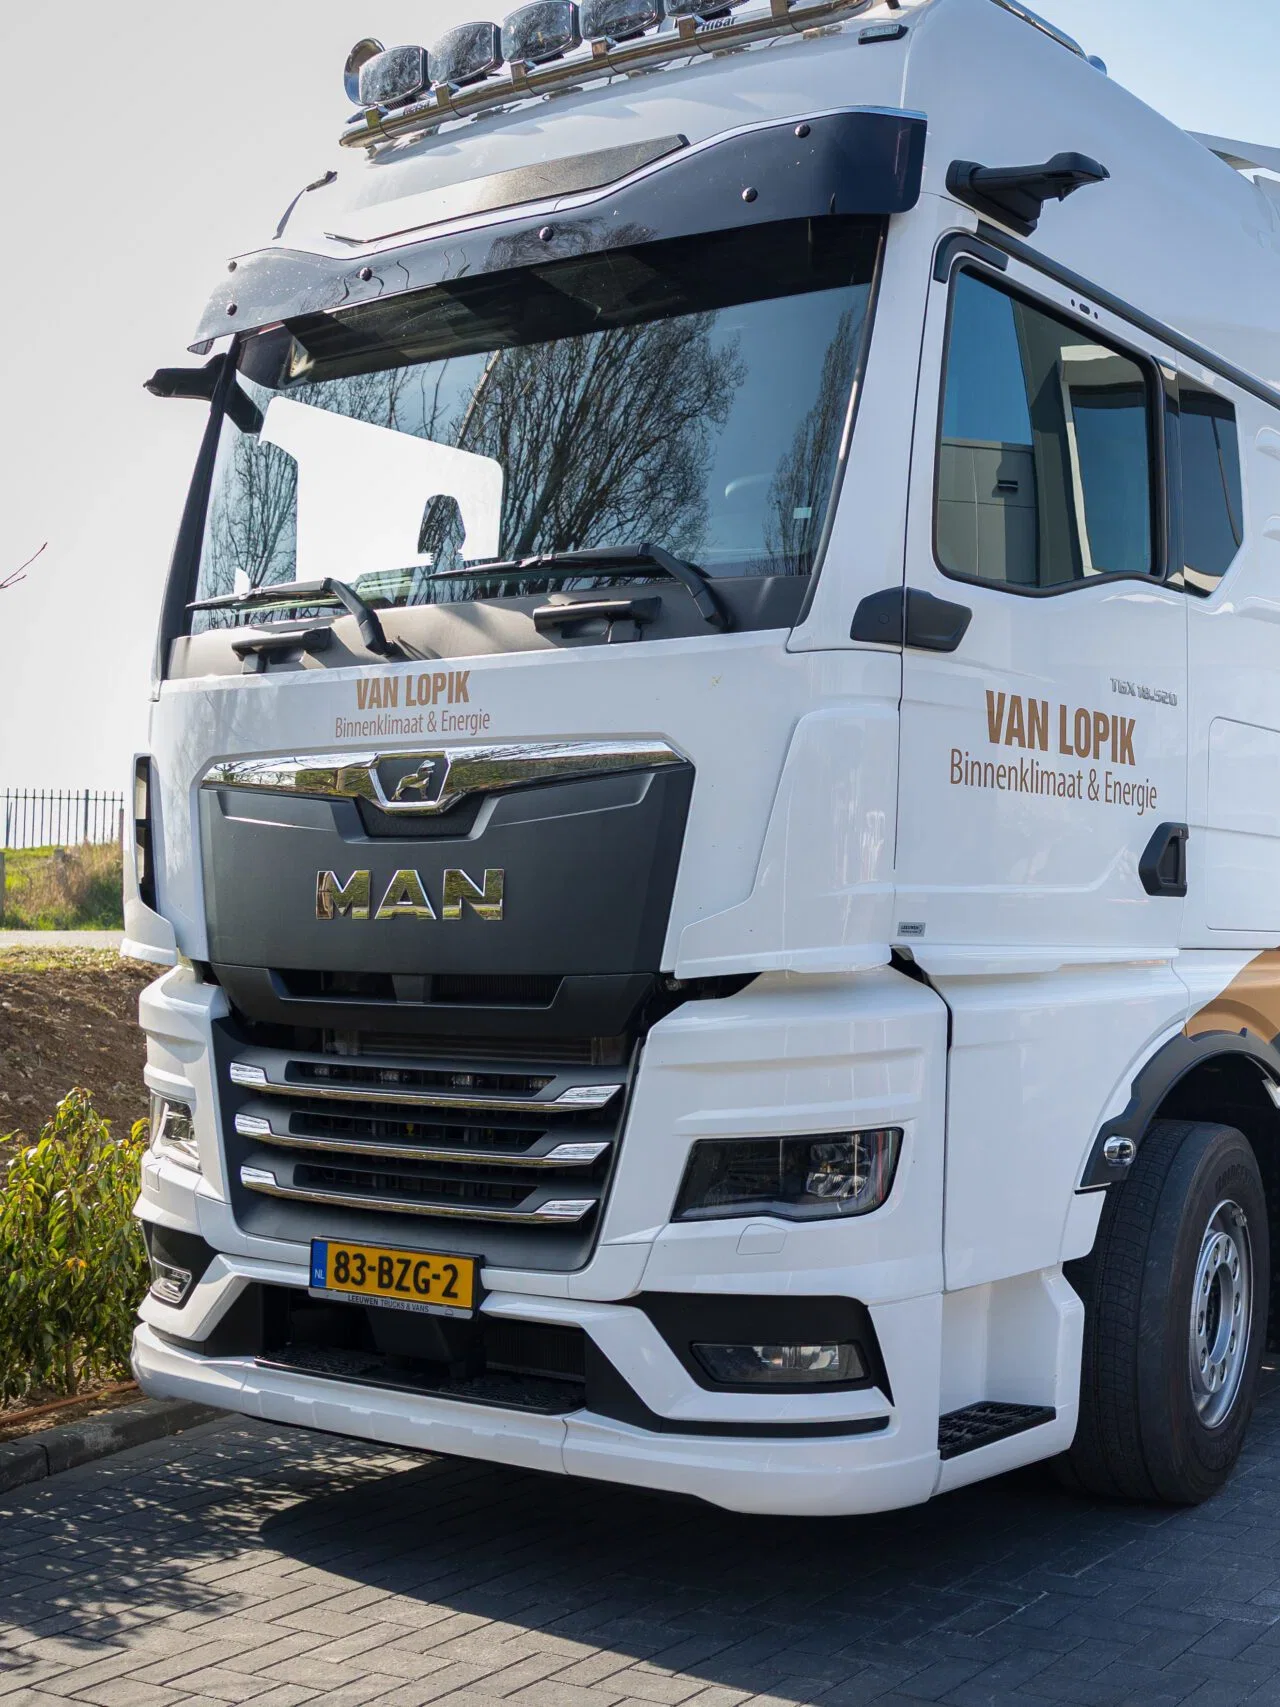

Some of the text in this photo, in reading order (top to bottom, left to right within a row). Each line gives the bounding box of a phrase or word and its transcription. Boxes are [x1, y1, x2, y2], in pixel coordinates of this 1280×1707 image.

[356, 670, 471, 710] VAN LOPIK
[1110, 678, 1136, 697] TGX
[335, 708, 491, 739] Binnenklimaat & Energie
[985, 689, 1136, 766] VAN LOPIK
[950, 748, 1157, 816] Binnenklimaat & Energie
[315, 868, 505, 921] MAN
[314, 1250, 459, 1299] NL 83-BZG-2
[347, 1294, 378, 1306] LEEUWEN
[381, 1299, 405, 1310] TRUCKS
[411, 1303, 430, 1313] VANS
